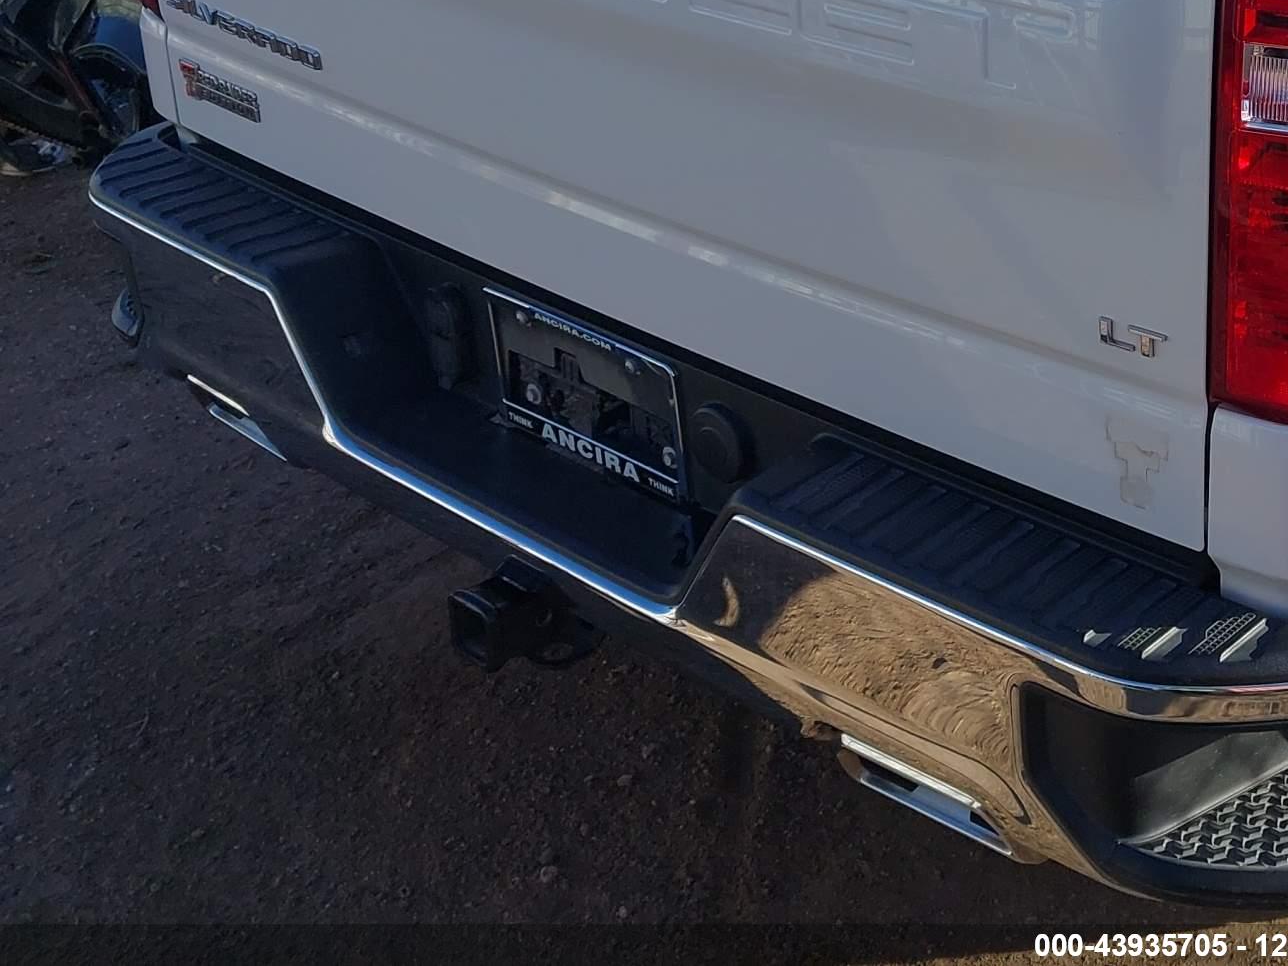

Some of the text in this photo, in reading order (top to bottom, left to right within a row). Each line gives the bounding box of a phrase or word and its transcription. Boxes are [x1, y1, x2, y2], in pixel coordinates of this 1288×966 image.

[533, 312, 613, 351] ANCIRA.COM
[1099, 315, 1168, 358] LT
[508, 411, 675, 497] THINK ANCIRA THINK
